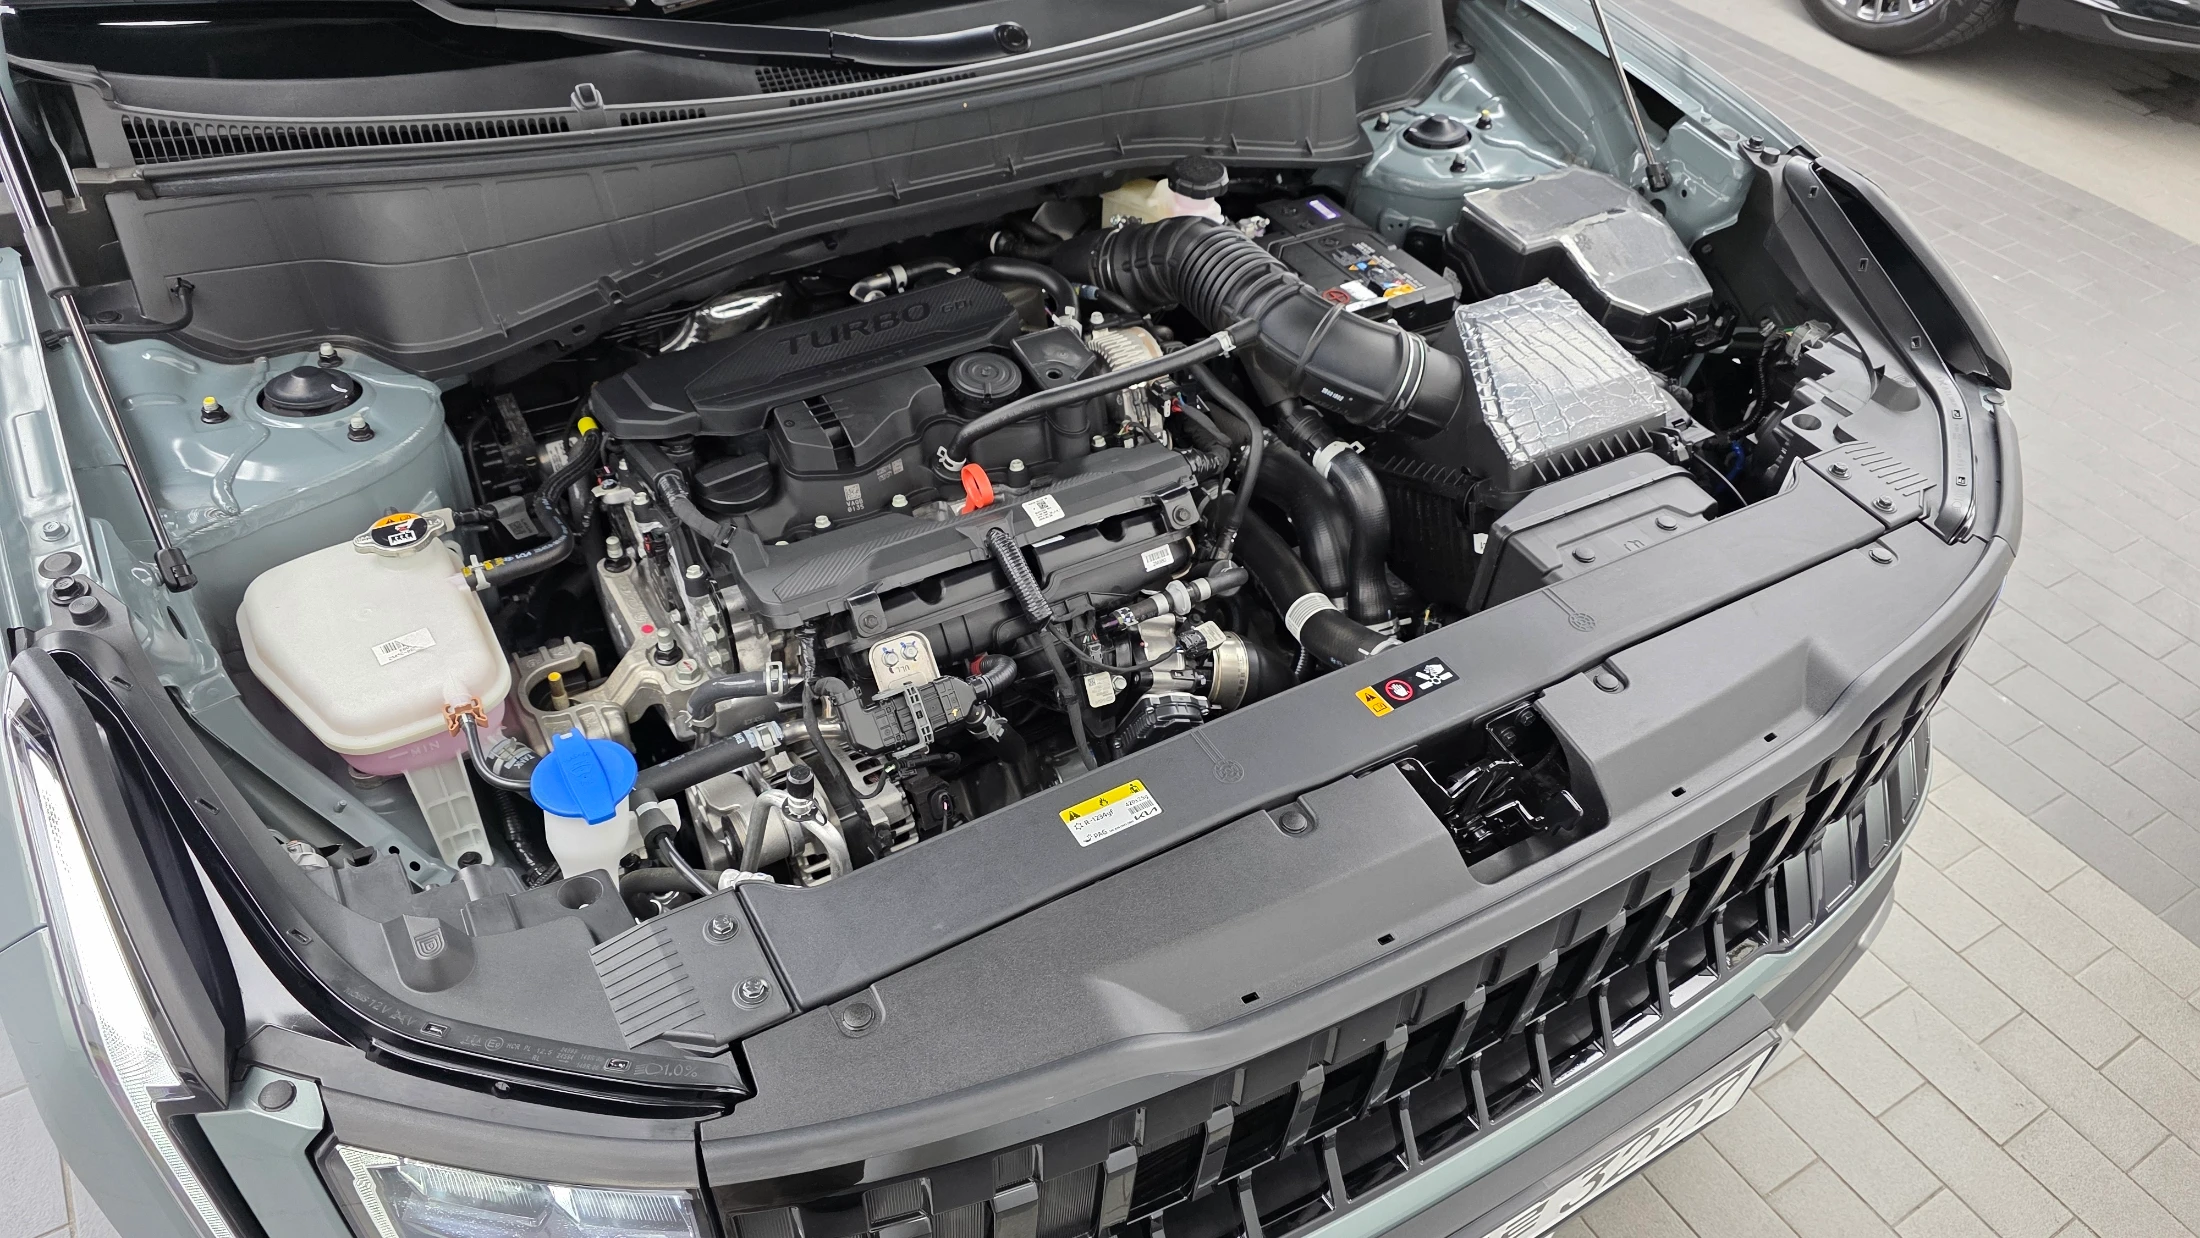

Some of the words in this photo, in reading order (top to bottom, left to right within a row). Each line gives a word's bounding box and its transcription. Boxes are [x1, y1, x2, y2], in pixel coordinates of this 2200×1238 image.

[778, 301, 931, 355] TURBO
[410, 740, 440, 758] MIN
[513, 754, 536, 770] TANK
[1083, 808, 1114, 827] R-1234yf
[1559, 1064, 1752, 1214] 3227
